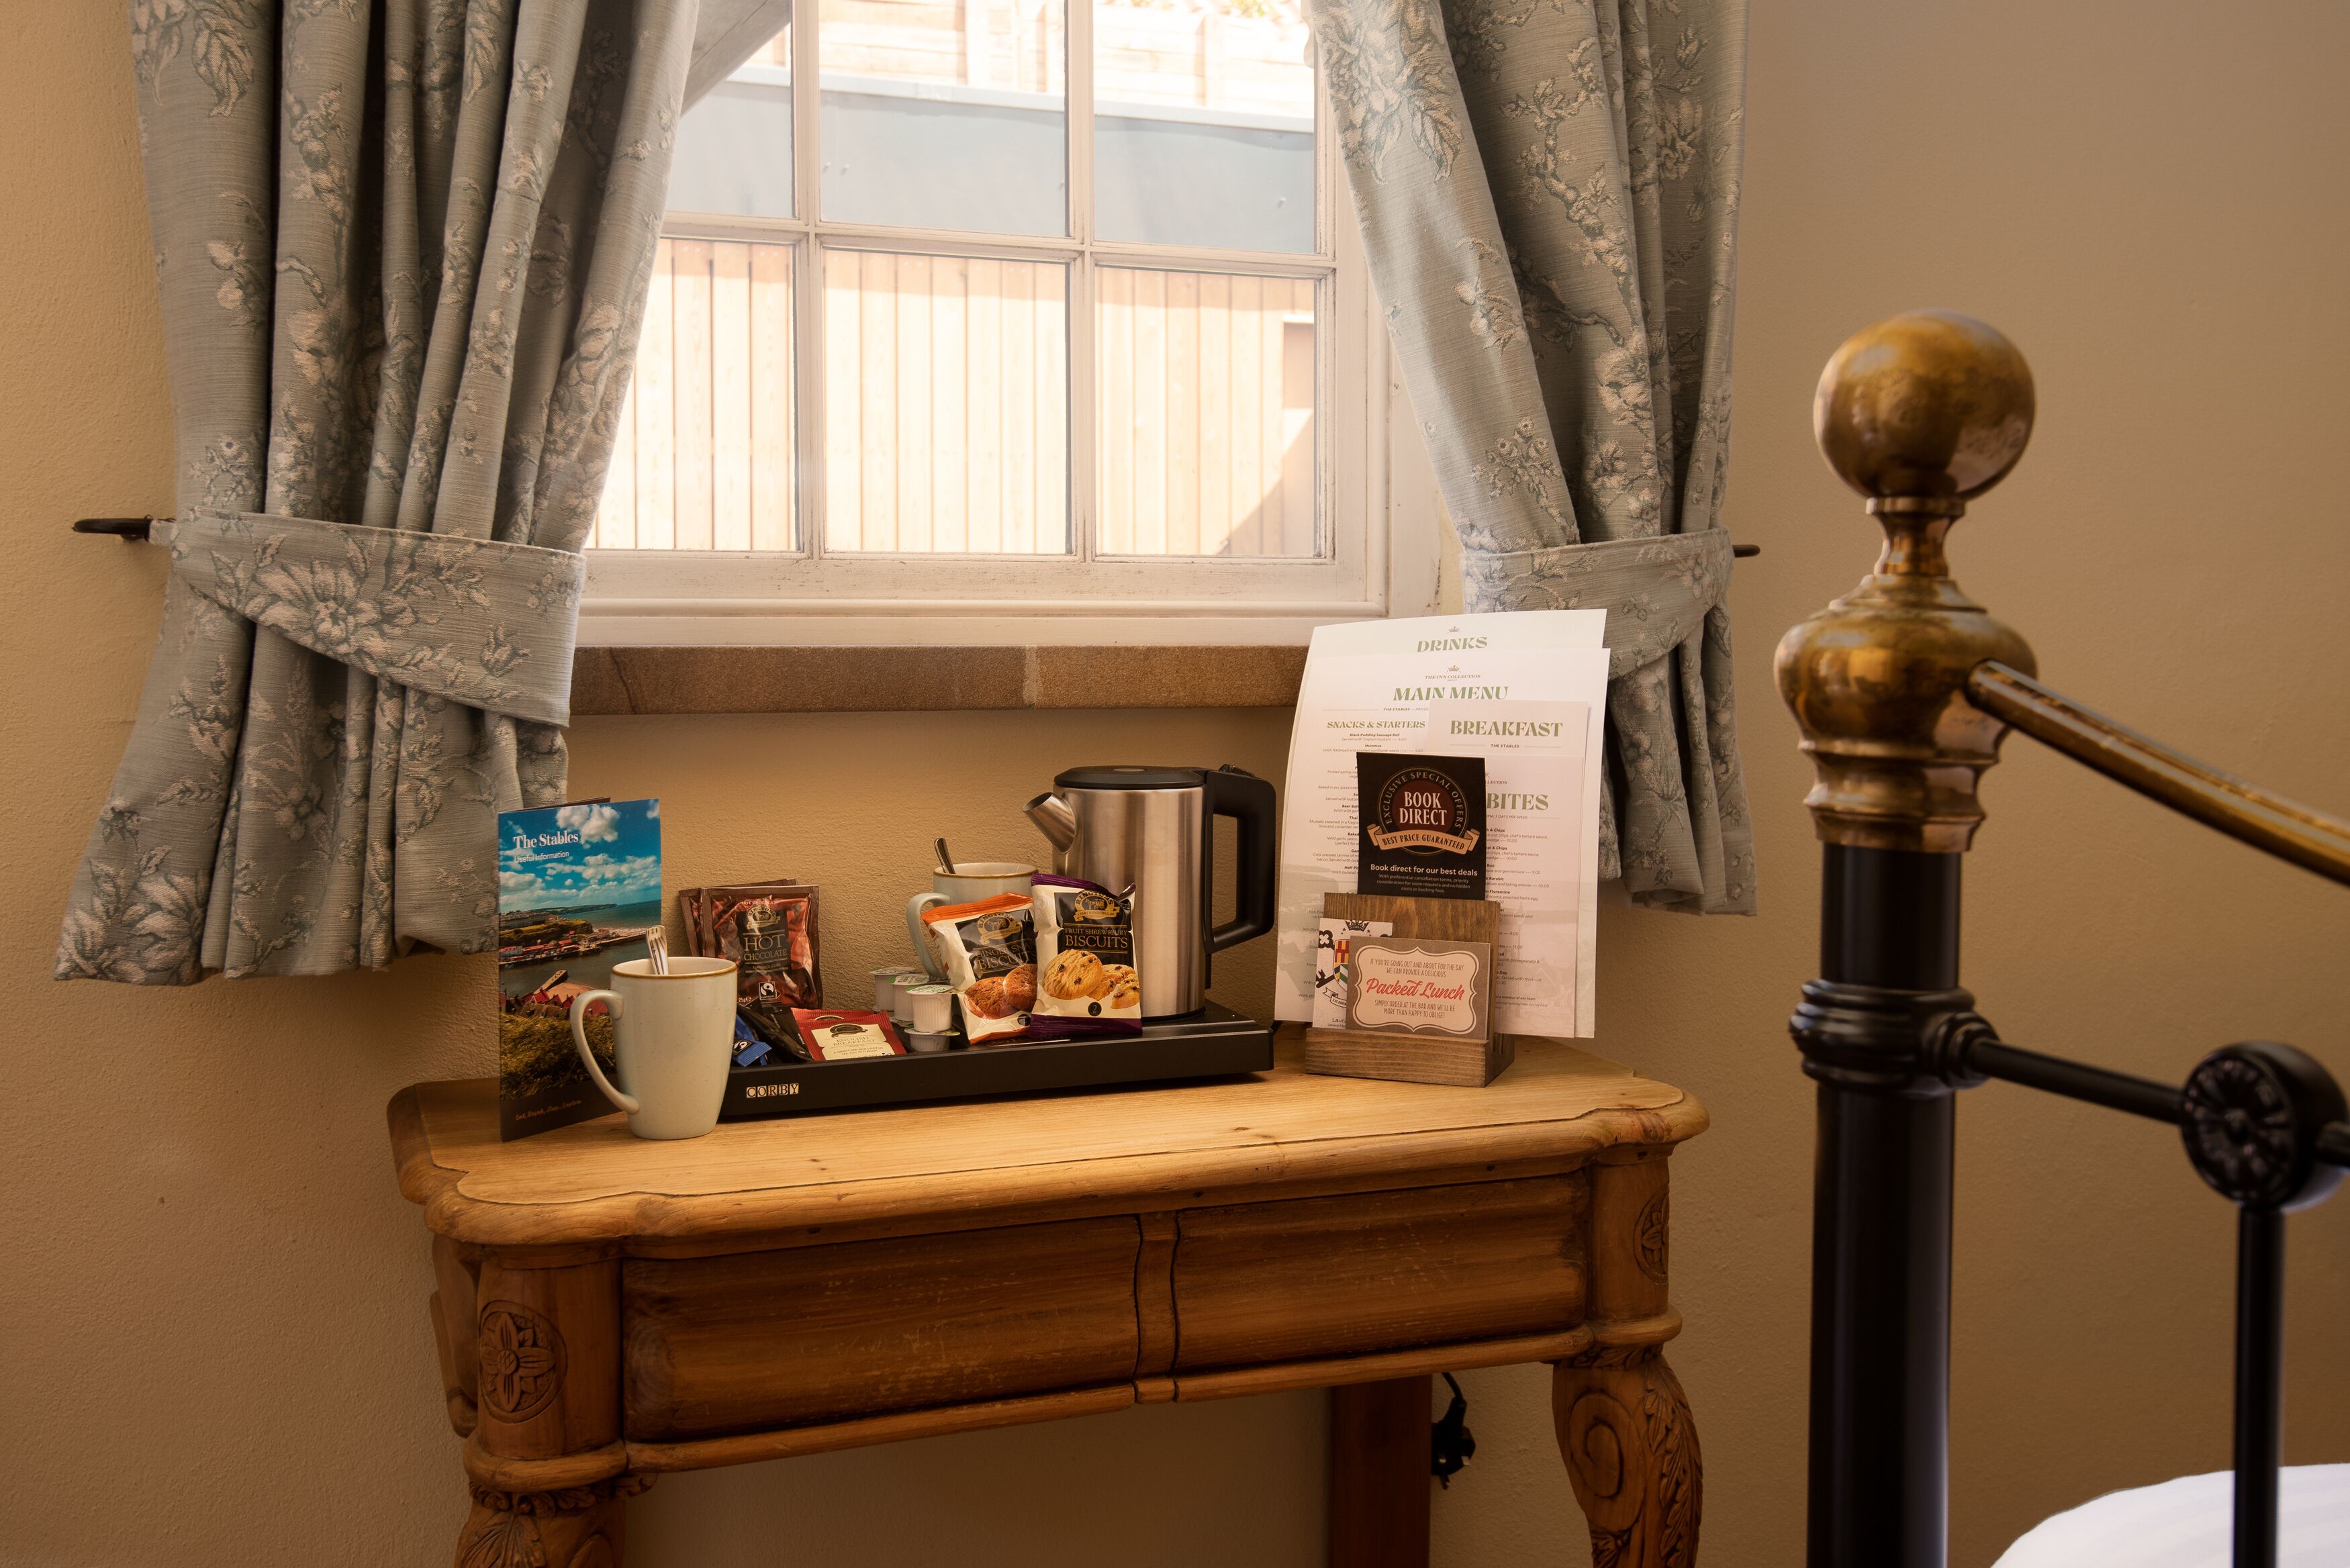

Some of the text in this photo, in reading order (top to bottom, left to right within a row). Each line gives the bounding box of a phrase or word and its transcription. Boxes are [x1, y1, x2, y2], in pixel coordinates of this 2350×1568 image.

[1417, 637, 1488, 652] DRINKS
[1393, 686, 1509, 701] MAIN MENU
[1450, 720, 1563, 737] BREAKFAST
[1383, 772, 1464, 828] EXCLUSIVE SPECIAL OFFERS
[1404, 791, 1442, 808] BOOK
[1487, 793, 1549, 811] BITES
[1399, 808, 1448, 826] DIRECT
[513, 830, 579, 848] The Stables
[1382, 834, 1465, 850] BEST PRICE GUARANTEED
[514, 850, 569, 863] Useful Information
[1390, 865, 1412, 873] direct
[1076, 891, 1114, 905] RINGTONS
[978, 912, 1017, 928] RINGTONS
[744, 934, 786, 951] HOT
[1065, 934, 1128, 948] BISCUITS
[744, 949, 787, 961] CHOCOLATE
[976, 946, 1010, 957] GINGER
[1366, 977, 1465, 1000] Packed Lunch
[1092, 1004, 1097, 1014] 2
[1375, 999, 1389, 1007] SIMPLY
[1409, 1010, 1422, 1018] HAPPY
[833, 1039, 876, 1047] BREAKFAST
[747, 1083, 799, 1098] CORBY
